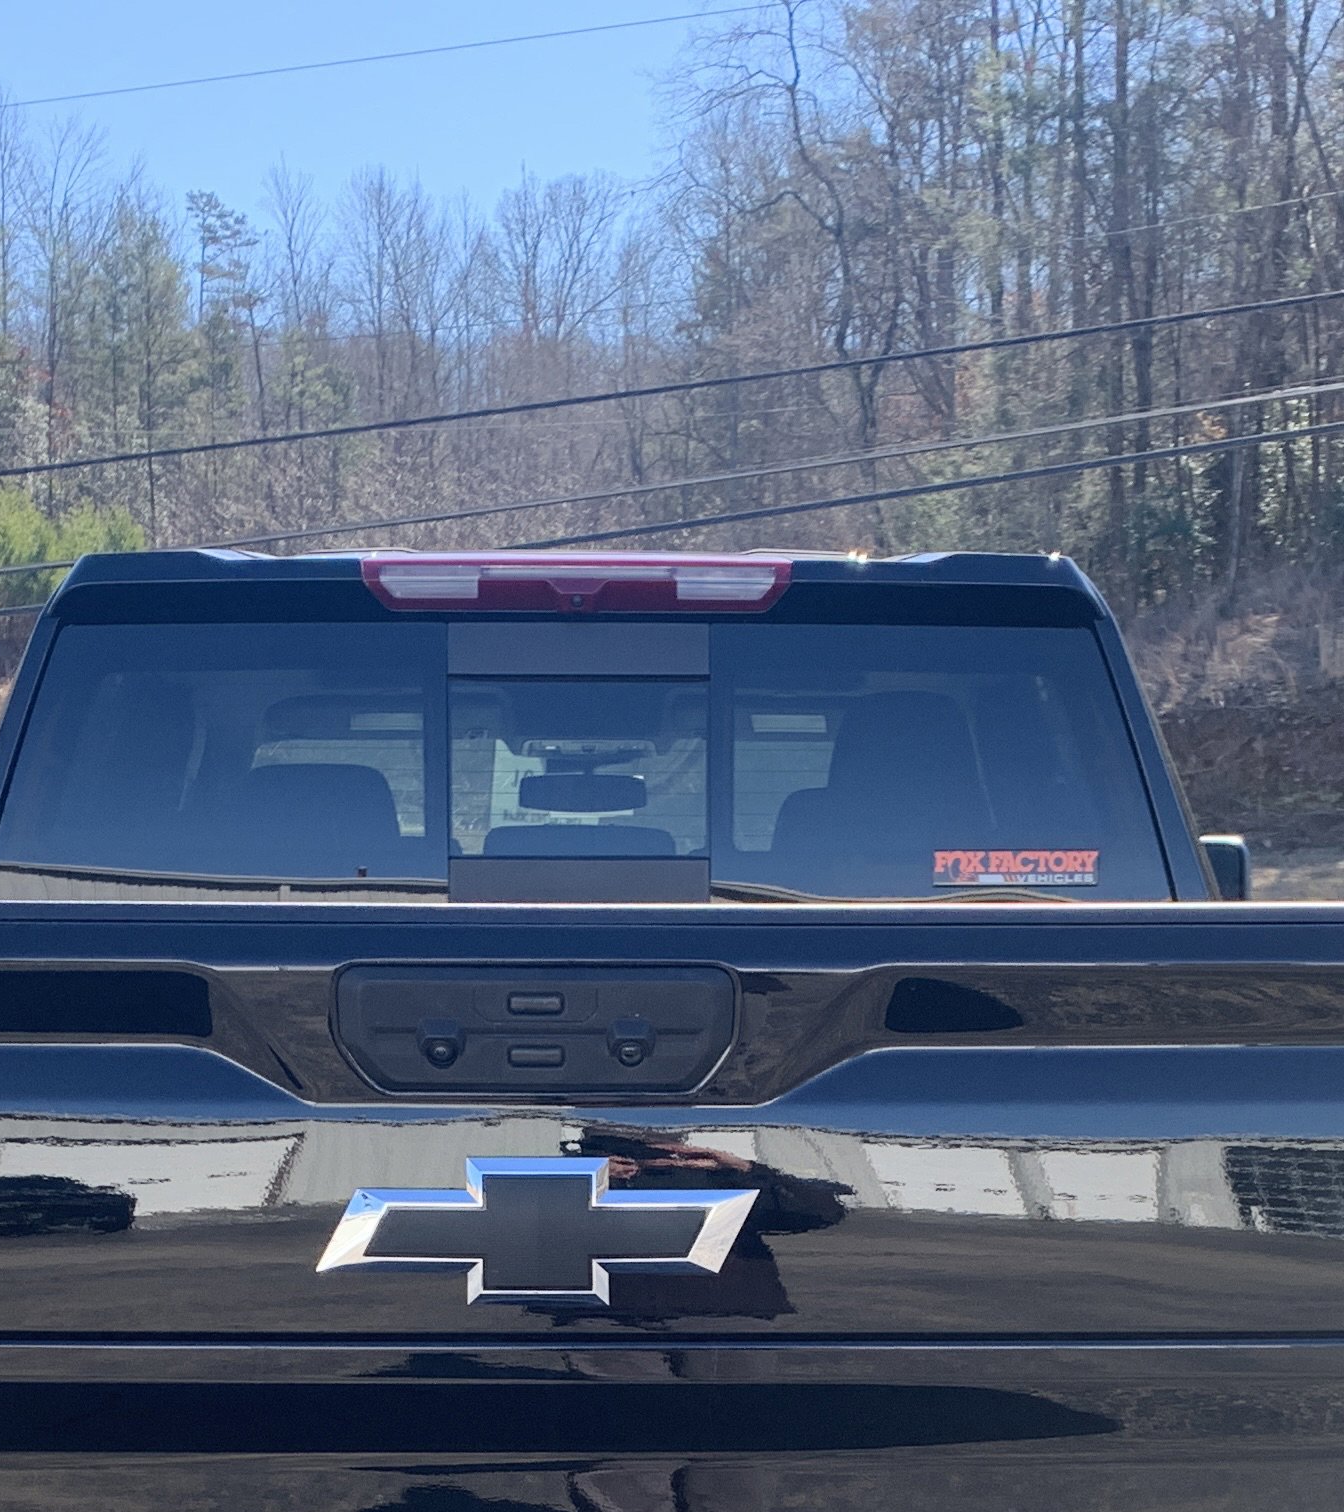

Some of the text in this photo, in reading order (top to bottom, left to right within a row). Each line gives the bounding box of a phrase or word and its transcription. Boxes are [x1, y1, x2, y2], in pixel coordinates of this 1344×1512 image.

[934, 851, 1099, 873] FOX FACTORY
[1016, 874, 1095, 883] VEHICLES
